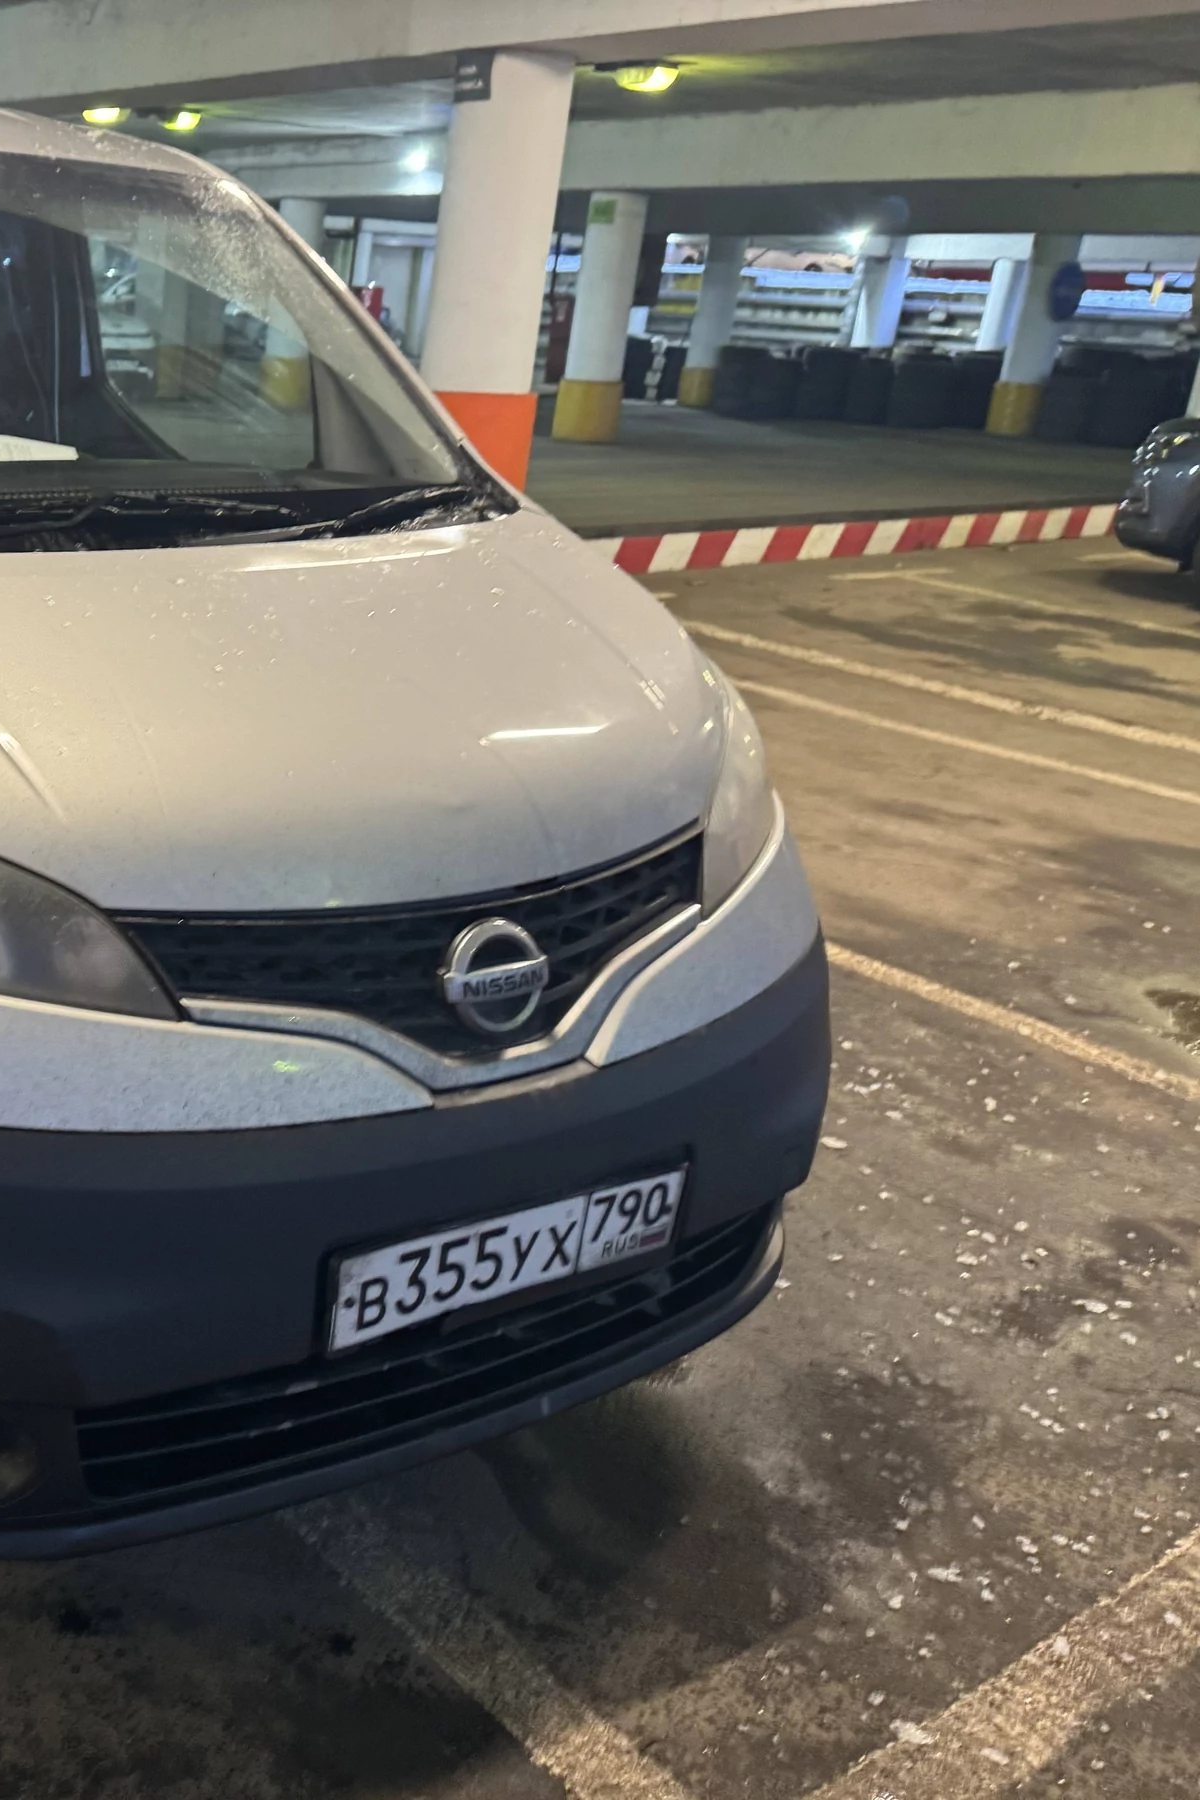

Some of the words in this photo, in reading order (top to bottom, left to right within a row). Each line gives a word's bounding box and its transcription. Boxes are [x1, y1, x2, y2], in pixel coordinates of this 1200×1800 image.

[463, 967, 543, 999] NISSAN
[591, 1182, 669, 1243] 790
[601, 1231, 639, 1259] RUS
